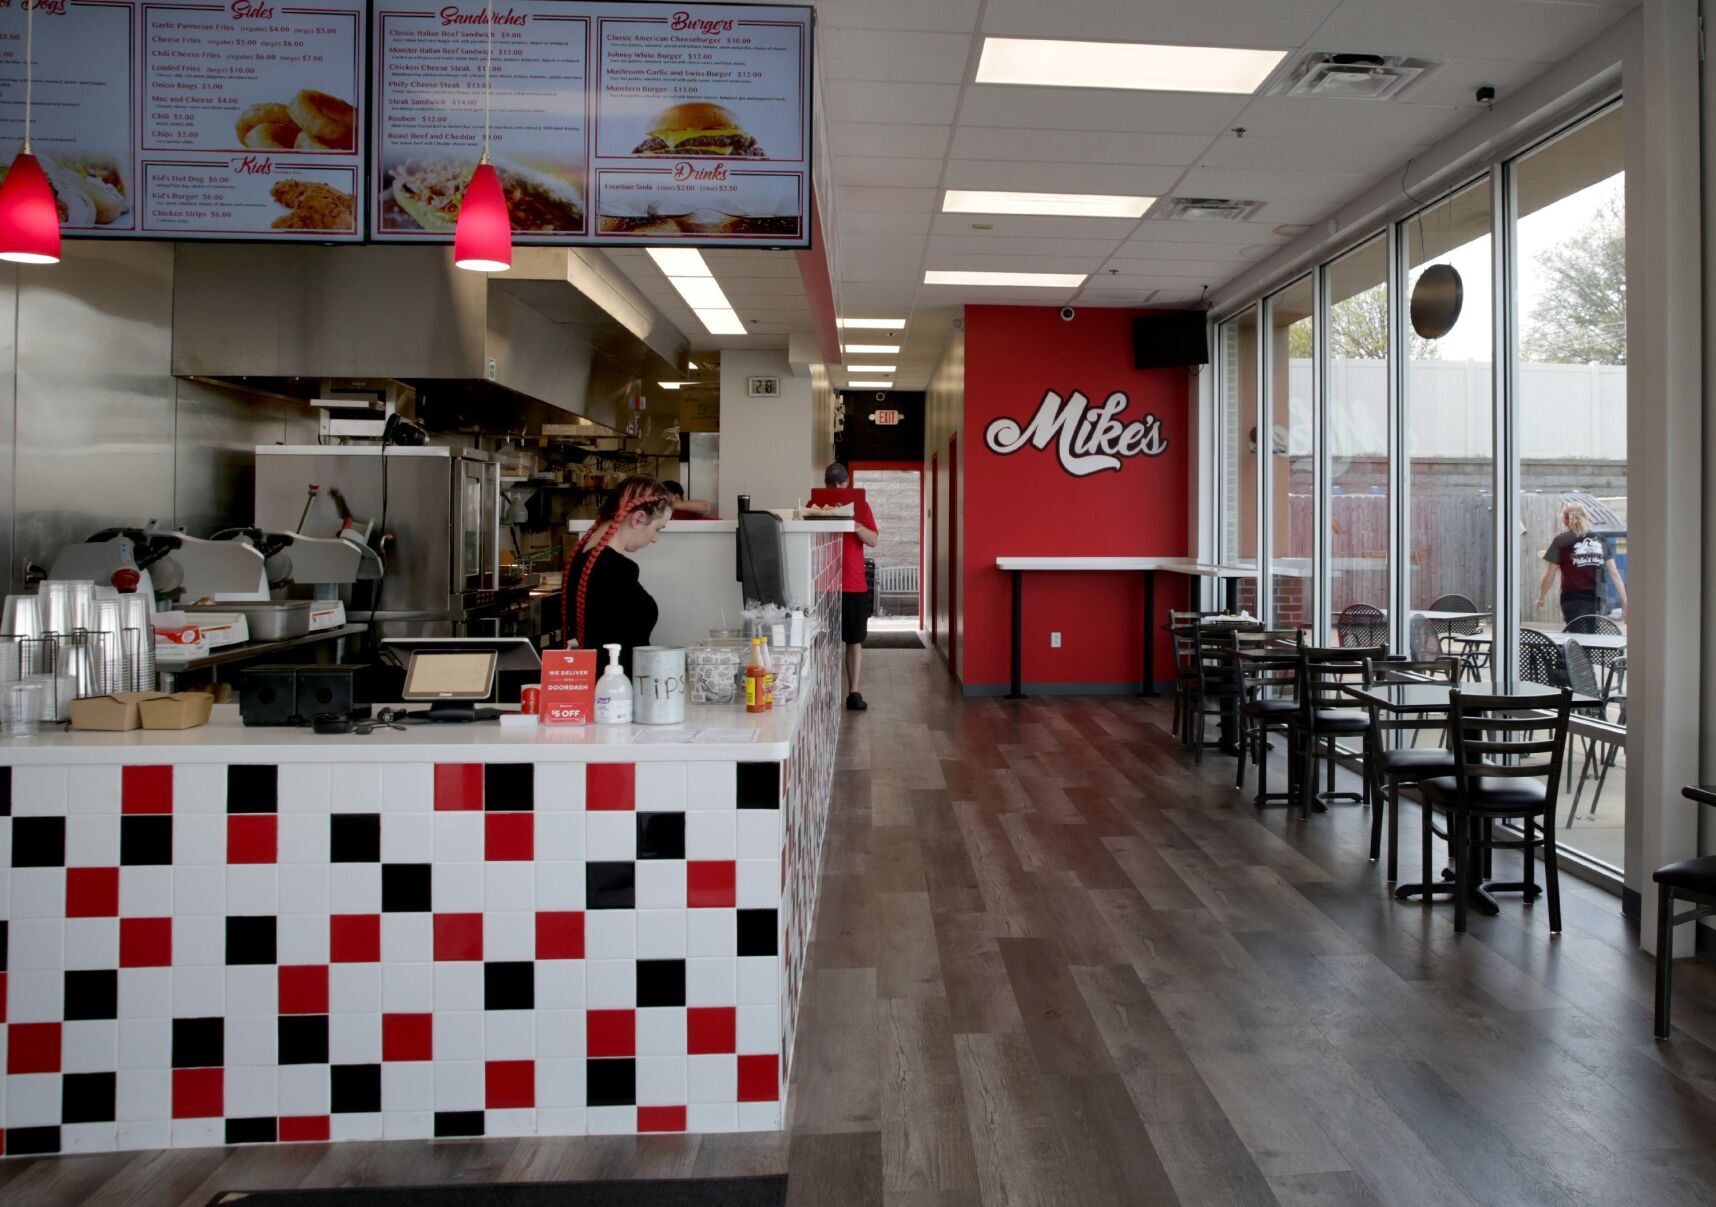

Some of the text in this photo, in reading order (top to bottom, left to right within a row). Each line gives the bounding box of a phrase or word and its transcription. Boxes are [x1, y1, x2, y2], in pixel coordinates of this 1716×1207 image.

[231, 0, 274, 20] Sides
[440, 6, 528, 26] Sandwiches
[216, 23, 234, 31] Fries
[671, 11, 734, 35] Burgers
[389, 29, 415, 37] Classic
[283, 40, 304, 48] $6.00
[670, 36, 721, 45] Cheeseburger
[607, 51, 632, 59] Johnny
[389, 81, 408, 89] Philly
[152, 112, 169, 120] Chili
[152, 130, 173, 138] Chips
[231, 156, 272, 175] Kids
[674, 161, 728, 181] Drinks
[188, 176, 205, 184] Dog
[880, 411, 895, 424] EXIT
[984, 388, 1168, 478] Mike's
[552, 710, 561, 718] $5
